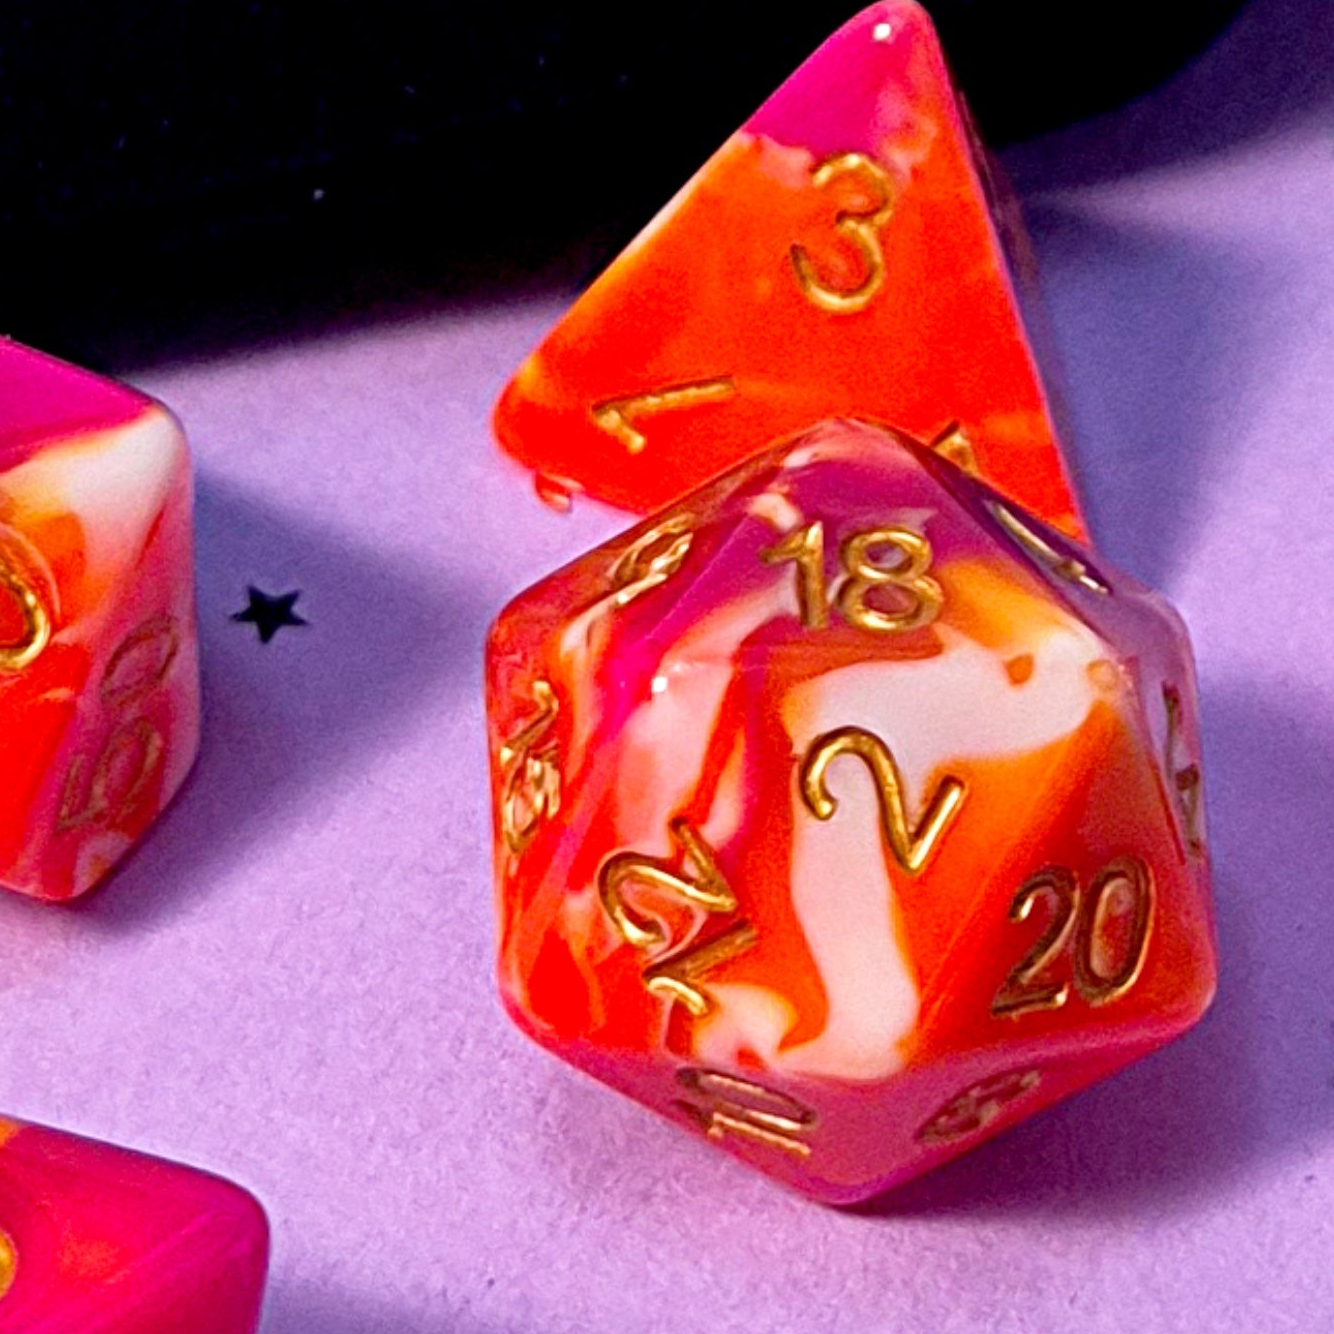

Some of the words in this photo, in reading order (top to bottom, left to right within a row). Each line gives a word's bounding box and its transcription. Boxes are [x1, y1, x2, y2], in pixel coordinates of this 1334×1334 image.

[789, 151, 896, 314] 3
[760, 520, 945, 633] 18
[798, 724, 969, 873] 2
[990, 853, 1157, 1019] 20
